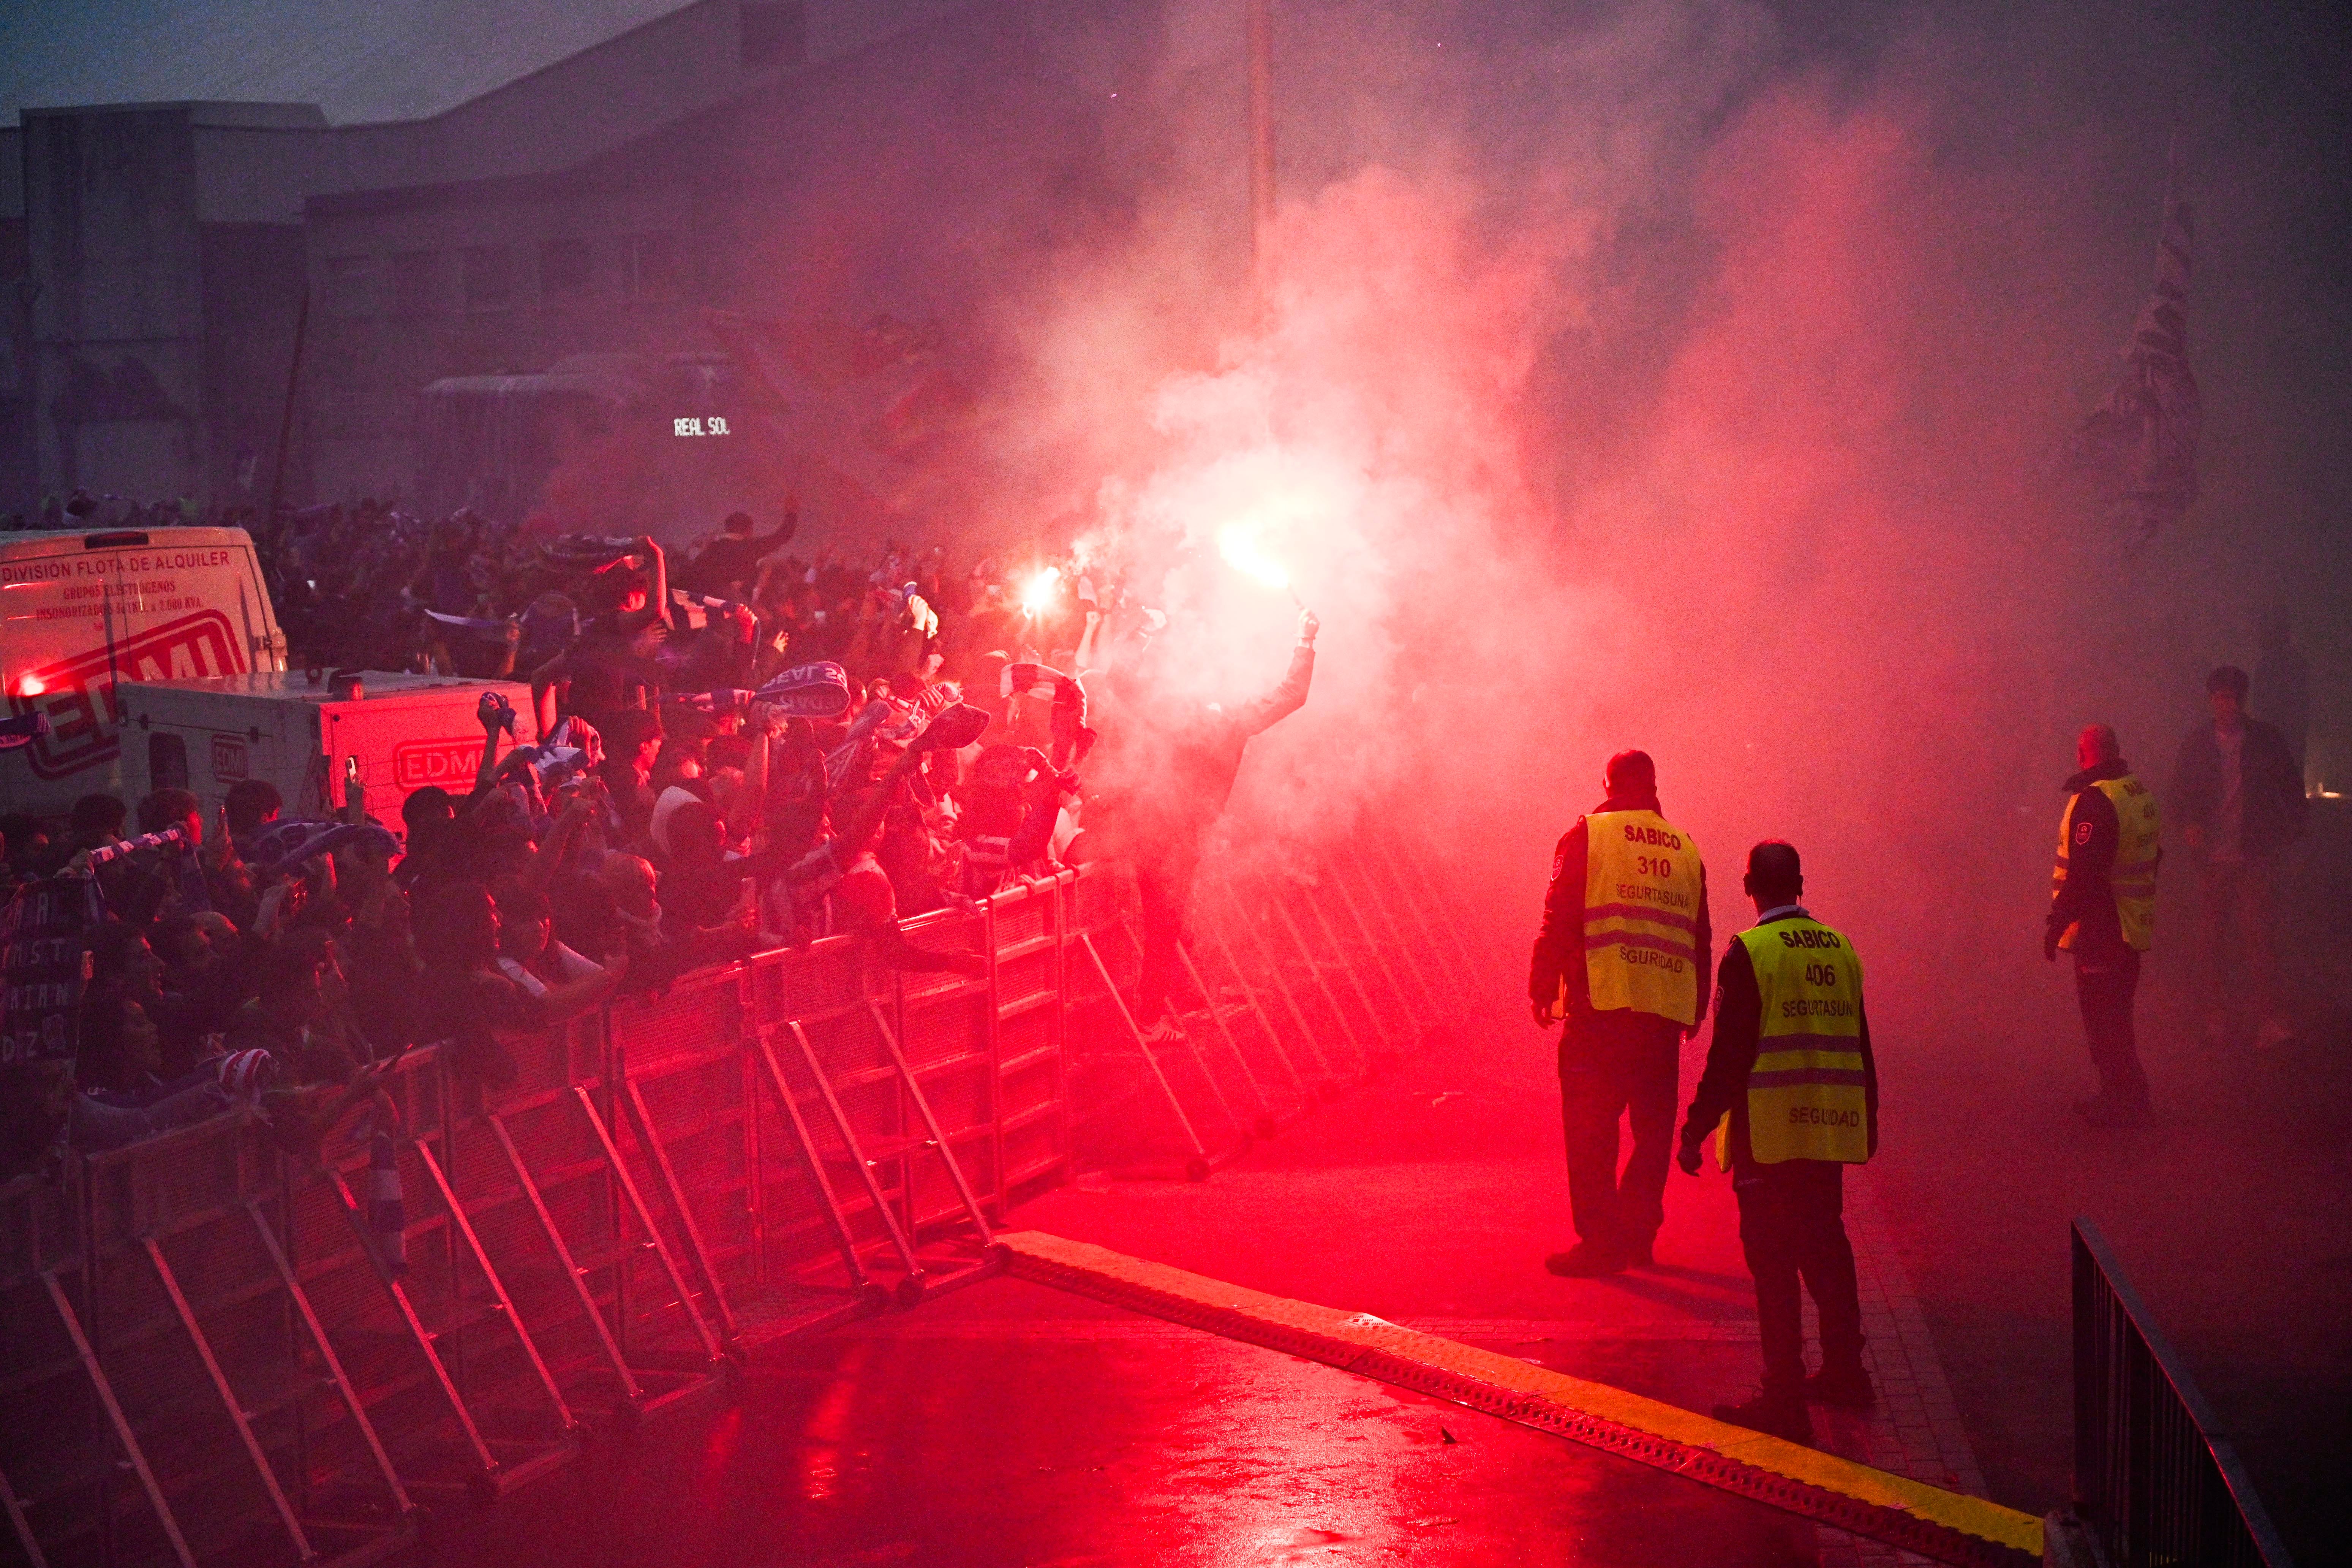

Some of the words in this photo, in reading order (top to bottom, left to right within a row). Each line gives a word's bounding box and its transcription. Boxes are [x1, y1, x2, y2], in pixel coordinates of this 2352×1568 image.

[674, 417, 706, 436] REAL
[2, 560, 71, 582] DIVISIÓN
[77, 558, 125, 576] FLOTA
[130, 558, 150, 572] DE
[156, 551, 230, 570] ALQUILER
[63, 585, 101, 600] GRUPOS
[36, 602, 113, 621] INSONORIZADOS
[185, 596, 204, 609] KVA.
[1625, 825, 1681, 851] SABICO
[1638, 856, 1671, 878] 310
[1779, 930, 1841, 949] SABICO
[1805, 964, 1836, 986] 406
[1782, 999, 1855, 1018] SEGURTASUN
